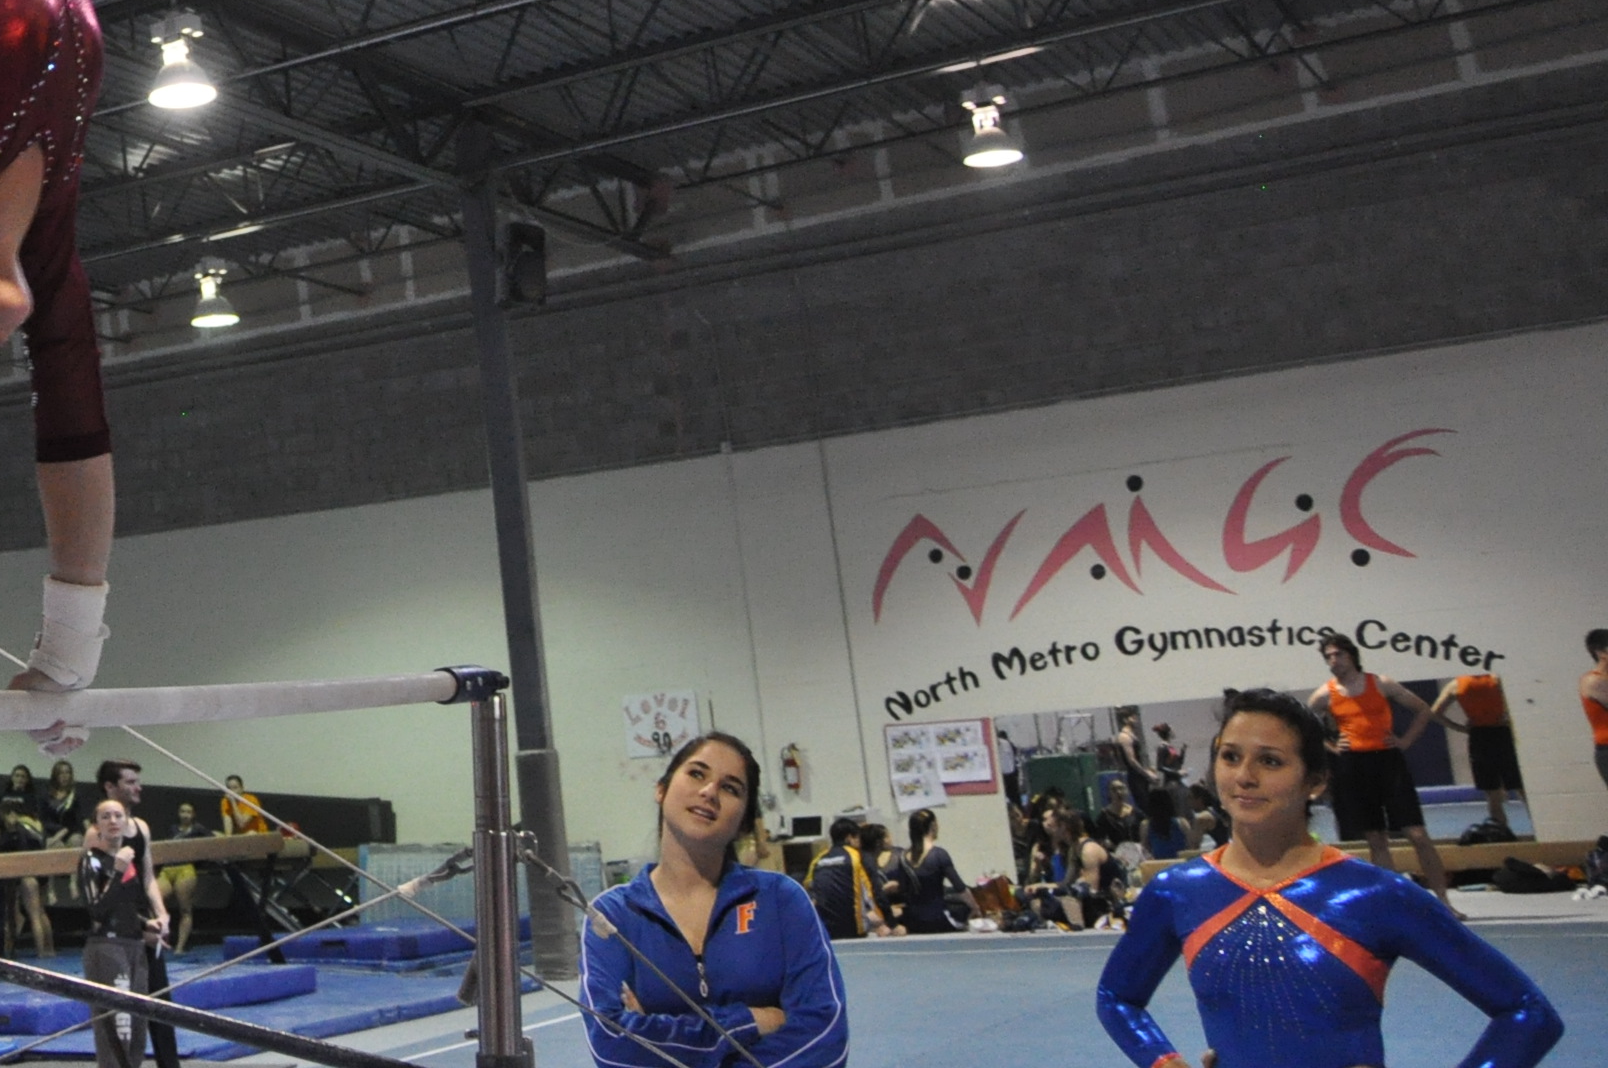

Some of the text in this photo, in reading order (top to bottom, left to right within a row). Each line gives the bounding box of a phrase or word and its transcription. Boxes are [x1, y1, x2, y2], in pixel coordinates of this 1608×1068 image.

[884, 619, 1505, 721] North Metro Gymnastics Center
[734, 900, 758, 935] F
